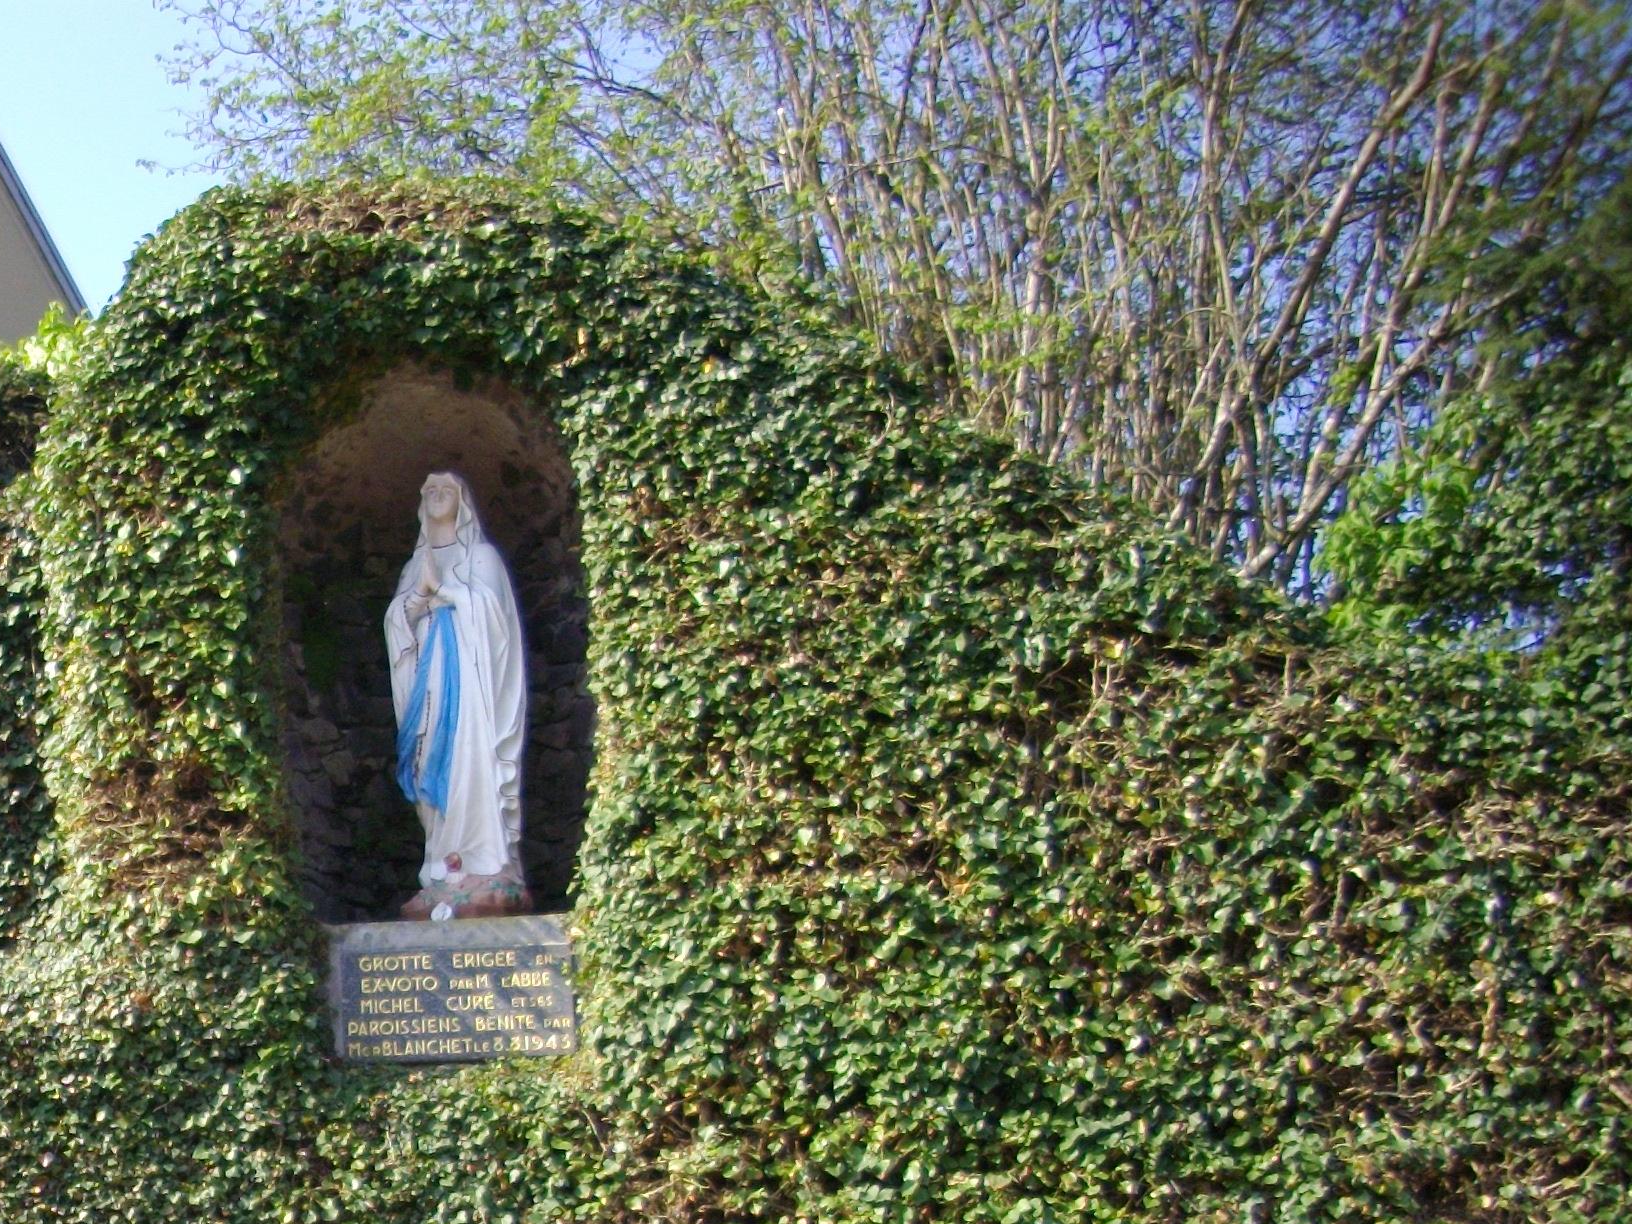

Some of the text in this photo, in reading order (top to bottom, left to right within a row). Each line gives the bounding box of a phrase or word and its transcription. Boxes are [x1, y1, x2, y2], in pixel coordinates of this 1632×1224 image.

[359, 955, 432, 972] GROTTE
[361, 976, 438, 993] EX-VOTO
[360, 997, 425, 1014] MICHEL
[347, 1017, 461, 1036] PAROISSIENS
[543, 1017, 571, 1029] PAR
[382, 1038, 472, 1057] BLANCHET
